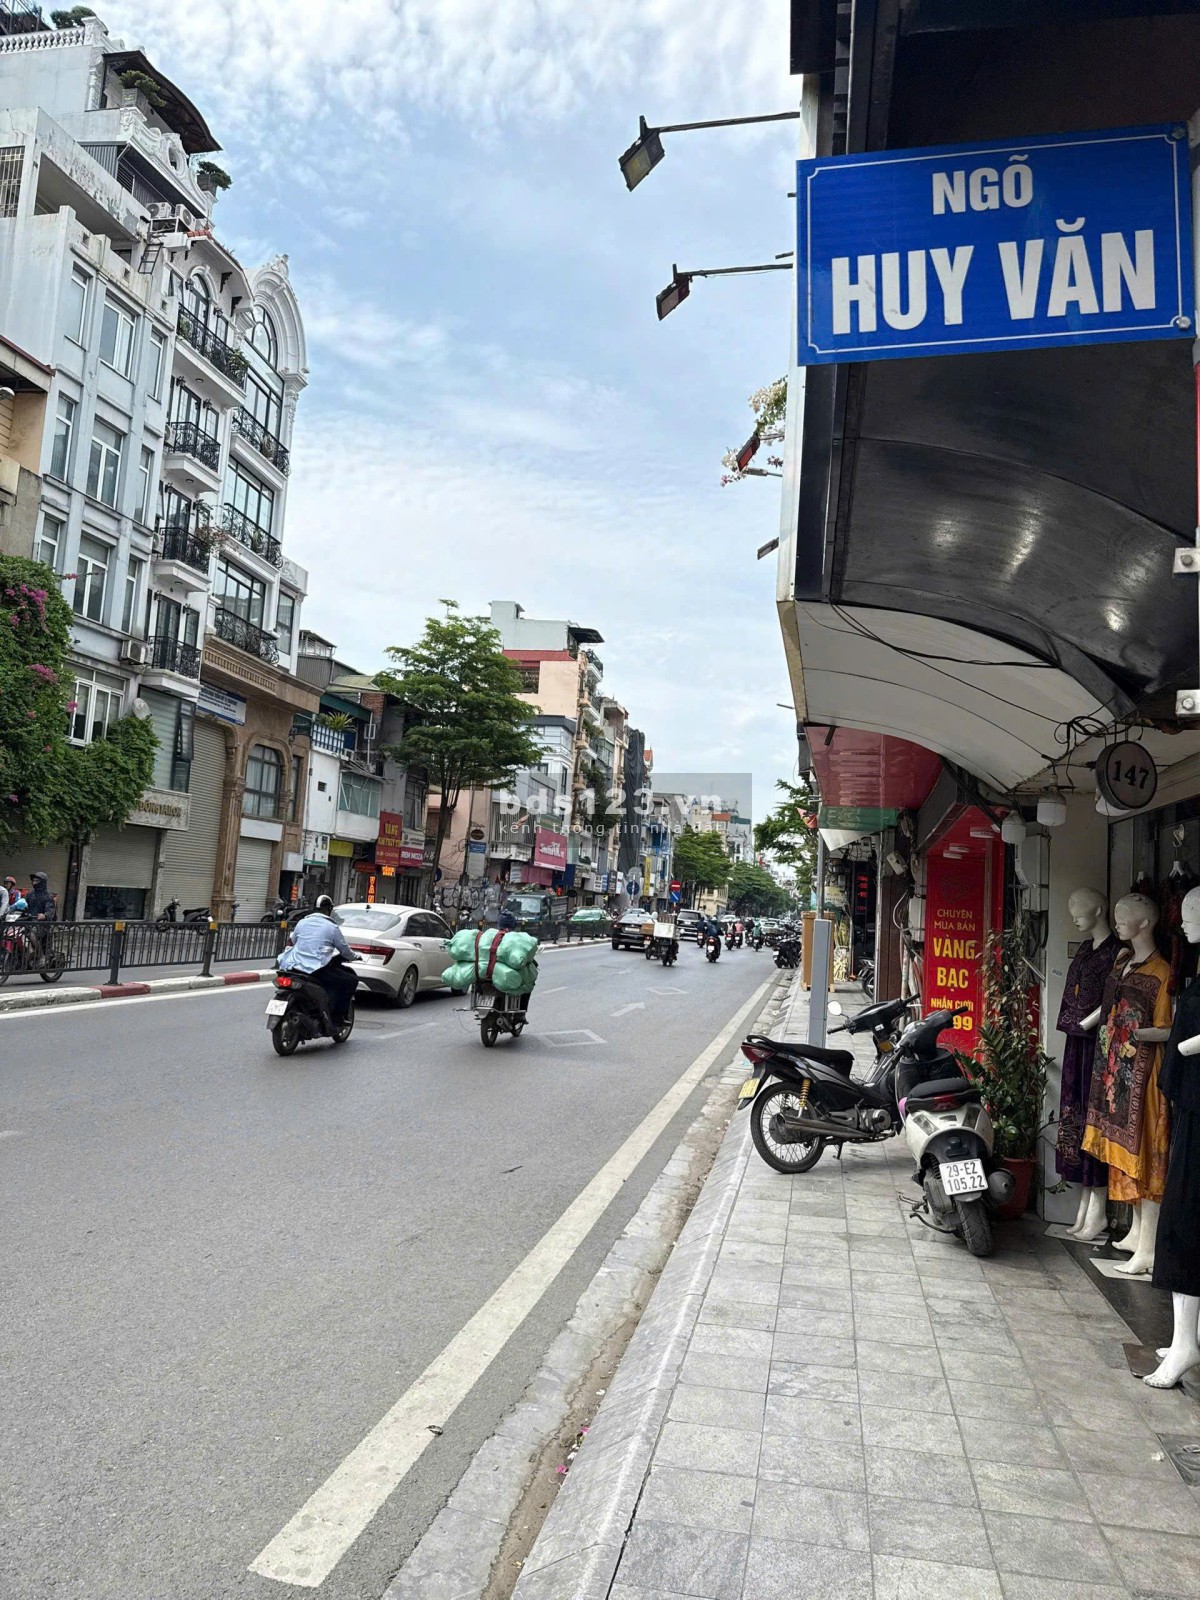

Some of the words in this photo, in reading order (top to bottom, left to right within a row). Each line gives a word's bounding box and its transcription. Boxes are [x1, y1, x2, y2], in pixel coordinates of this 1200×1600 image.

[932, 153, 1034, 215] NGÕ
[831, 245, 975, 335] HUY
[998, 216, 1156, 321] VĂN
[1112, 760, 1150, 790] 147
[934, 920, 955, 930] MUA
[957, 919, 976, 932] BÁN
[937, 908, 973, 919] CHUYÊN
[933, 935, 977, 960] VÀNG
[936, 966, 969, 992] BẠC
[946, 1161, 978, 1178] 29-E2
[947, 1175, 985, 1192] 105.22
